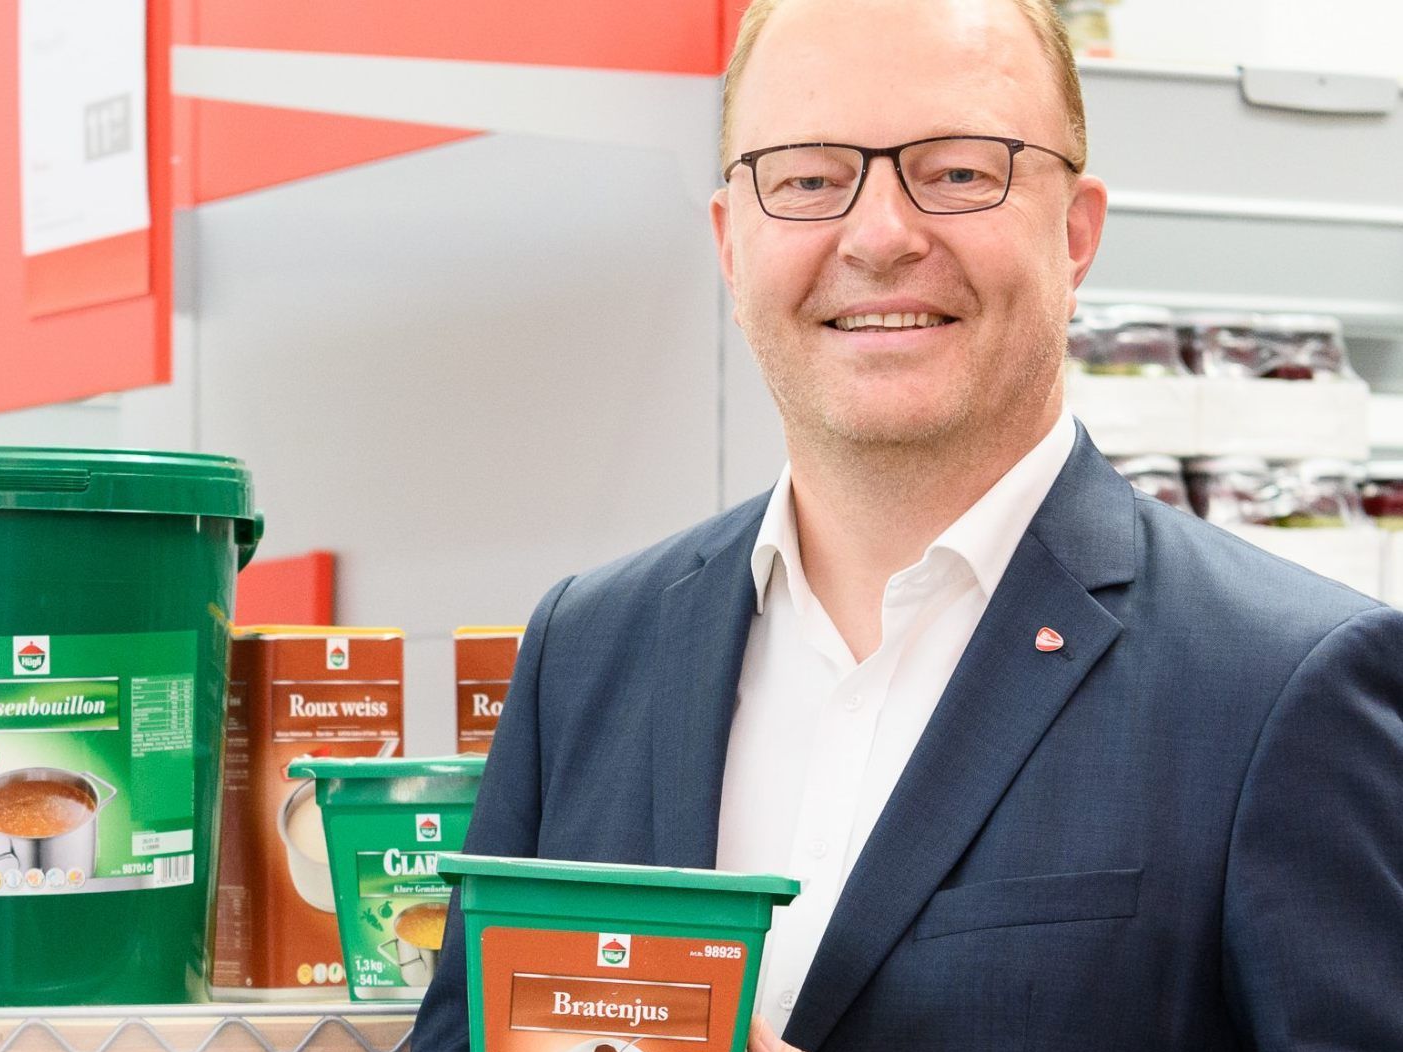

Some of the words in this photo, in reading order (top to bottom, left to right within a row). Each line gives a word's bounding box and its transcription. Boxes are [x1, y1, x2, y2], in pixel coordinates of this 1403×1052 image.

[289, 693, 338, 717] Roux
[340, 695, 388, 717] weiss
[472, 693, 504, 717] Ro
[383, 847, 439, 877] CLAR
[704, 945, 742, 960] 98925
[552, 991, 669, 1027] Bratenjus
